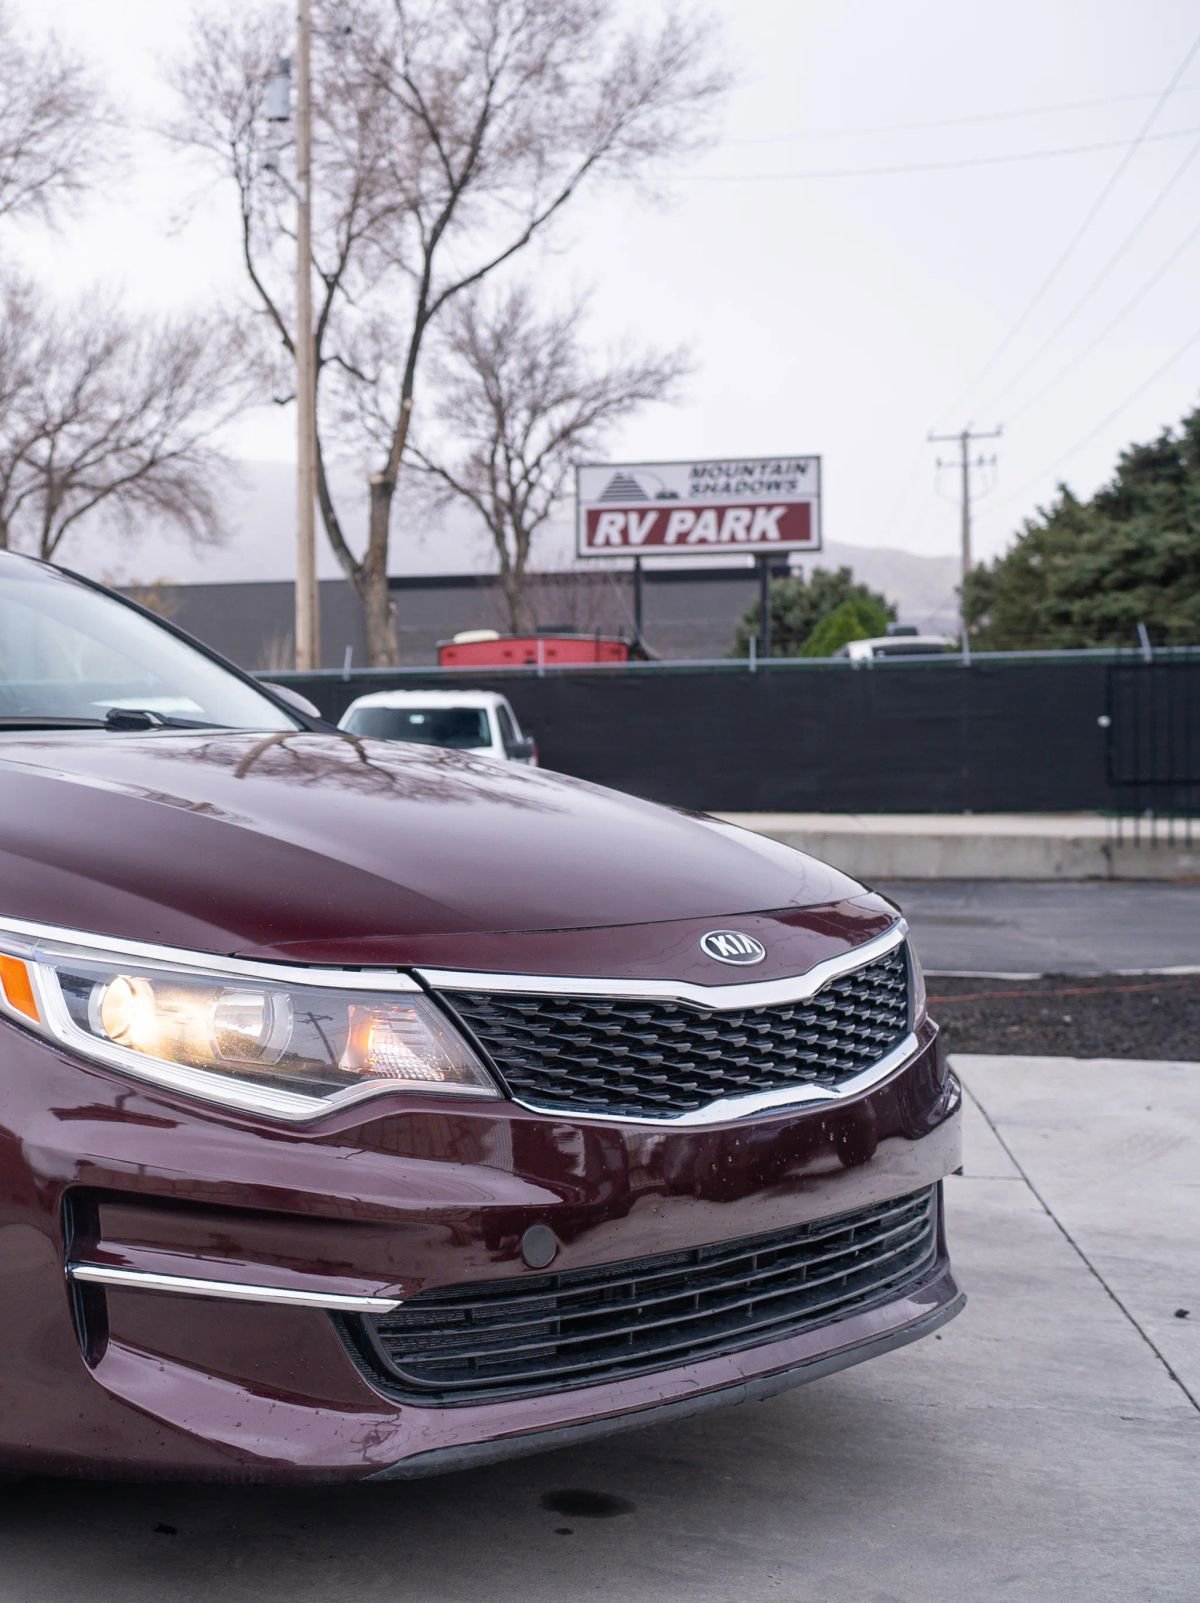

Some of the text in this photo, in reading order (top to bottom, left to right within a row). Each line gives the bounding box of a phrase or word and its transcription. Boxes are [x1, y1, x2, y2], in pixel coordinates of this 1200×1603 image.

[689, 463, 808, 478] MOUNTAIN
[689, 479, 798, 496] SHADOWS
[593, 505, 787, 546] RV PARK
[707, 934, 761, 957] KIA
